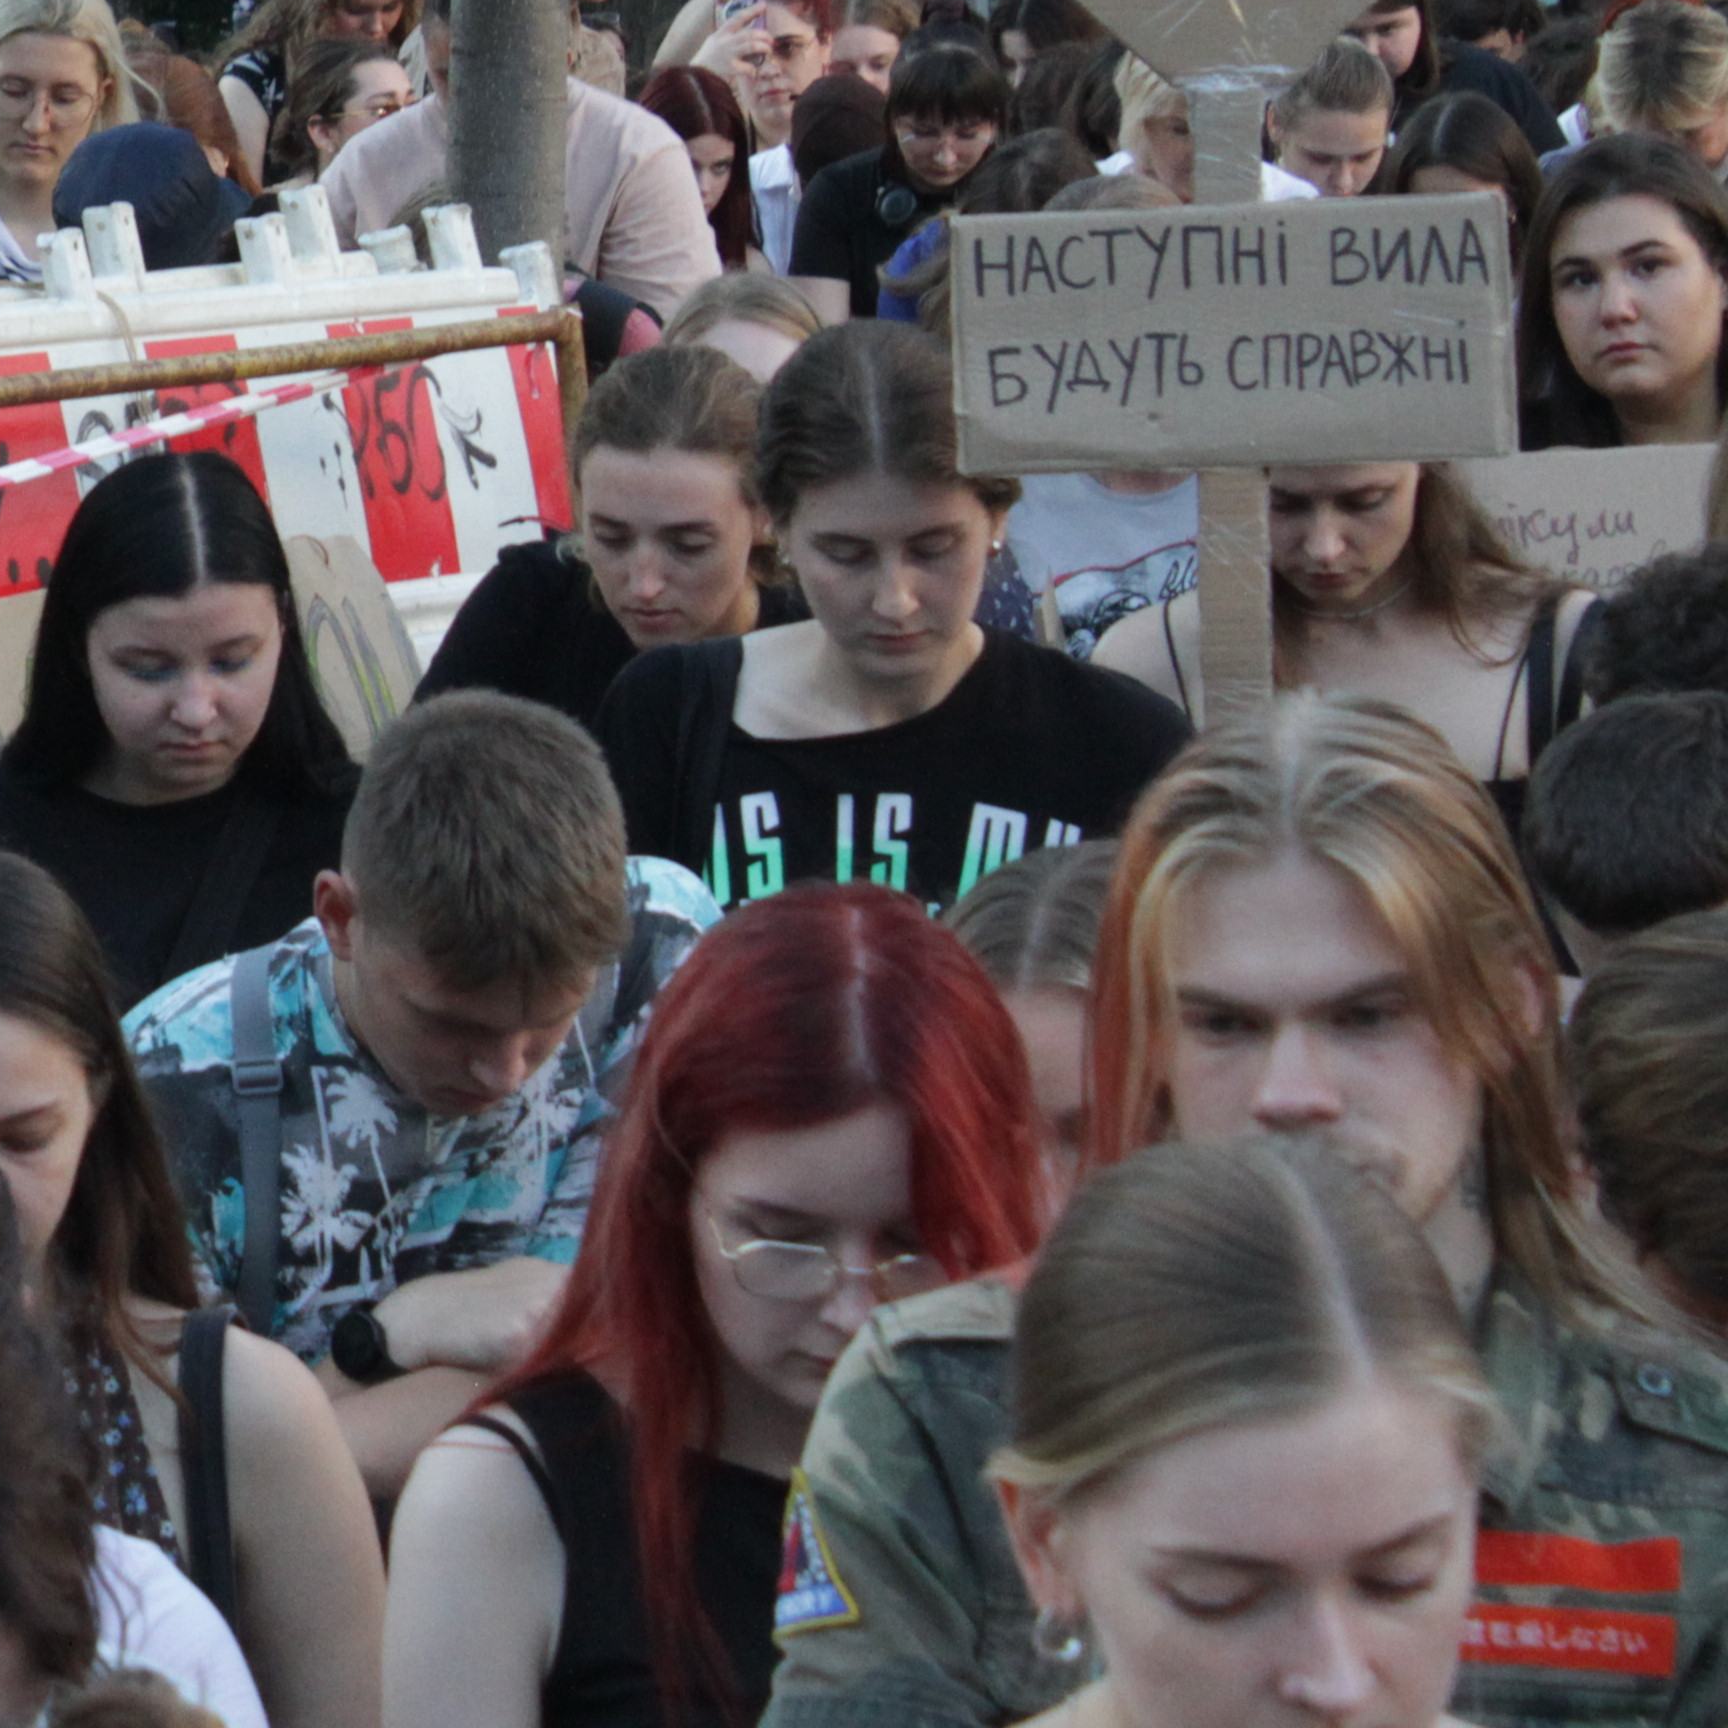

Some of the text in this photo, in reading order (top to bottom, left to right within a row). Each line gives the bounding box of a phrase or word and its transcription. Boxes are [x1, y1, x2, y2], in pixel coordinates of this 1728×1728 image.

[973, 218, 1490, 298] НАСТУПНІ ВИЛА
[987, 317, 1471, 413] БУДУТЬ СПРАВЖНІ
